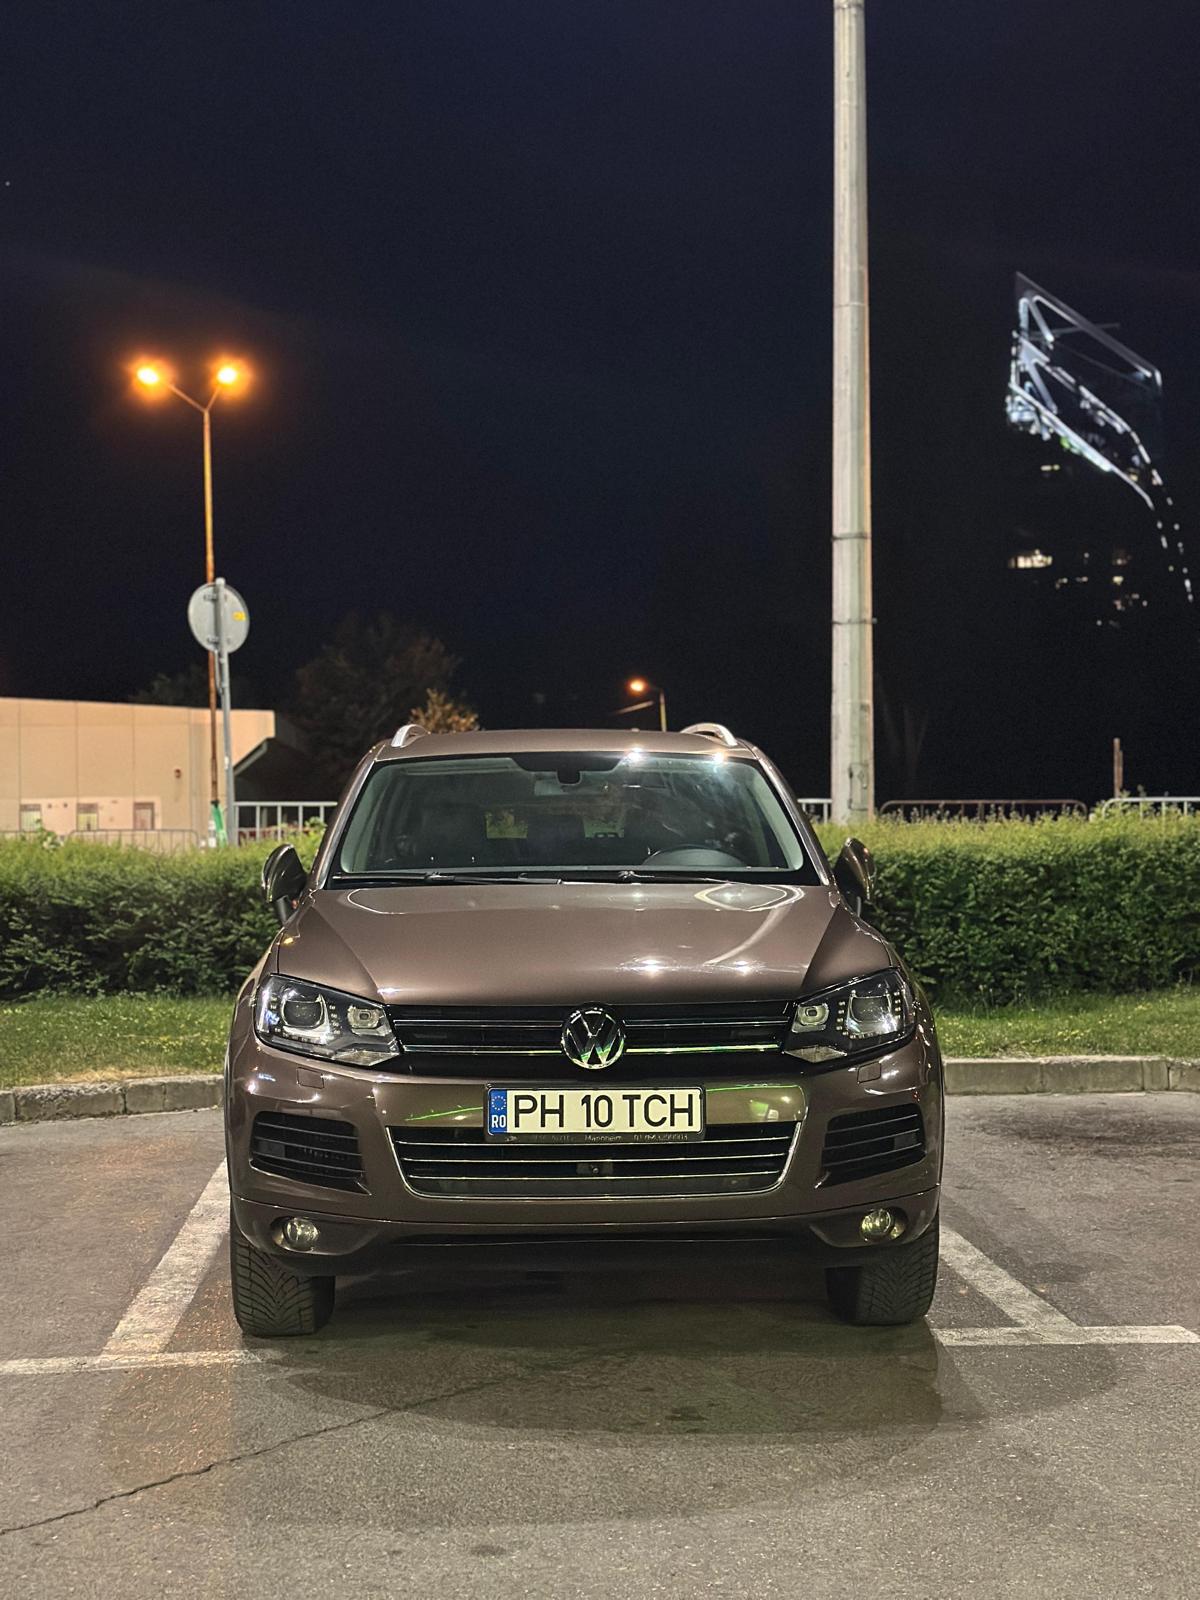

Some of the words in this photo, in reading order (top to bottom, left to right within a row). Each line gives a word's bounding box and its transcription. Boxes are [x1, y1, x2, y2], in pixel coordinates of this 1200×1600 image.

[562, 1007, 624, 1069] VW
[491, 1115, 506, 1128] RO
[514, 1094, 564, 1128] PH
[581, 1094, 613, 1128] 10
[622, 1093, 694, 1127] TCH
